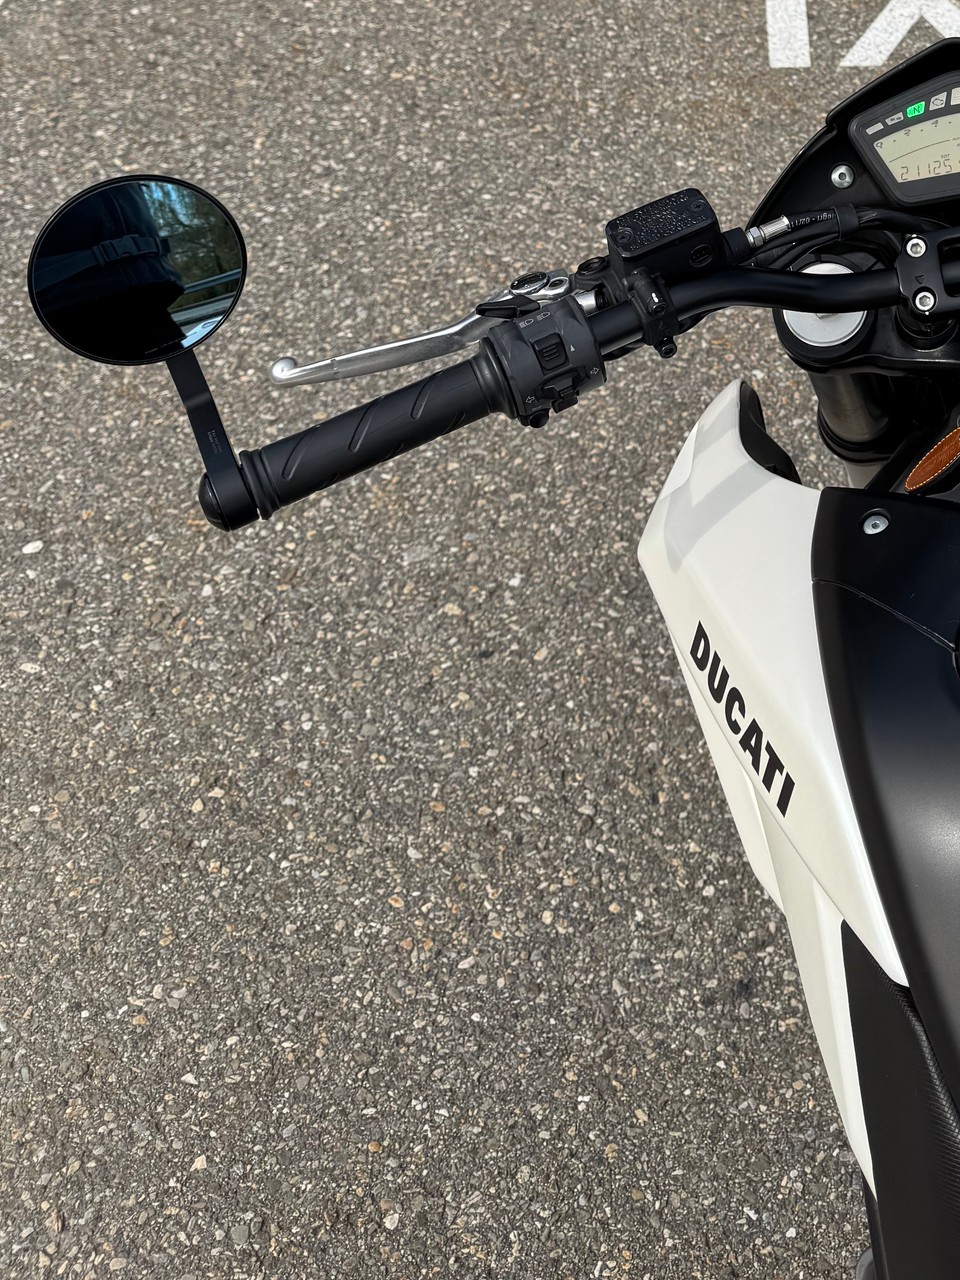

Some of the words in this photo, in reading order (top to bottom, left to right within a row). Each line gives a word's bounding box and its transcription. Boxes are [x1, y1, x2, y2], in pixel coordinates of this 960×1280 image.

[913, 105, 921, 114] N
[900, 158, 953, 181] 21125
[690, 620, 796, 818] DUCATI
